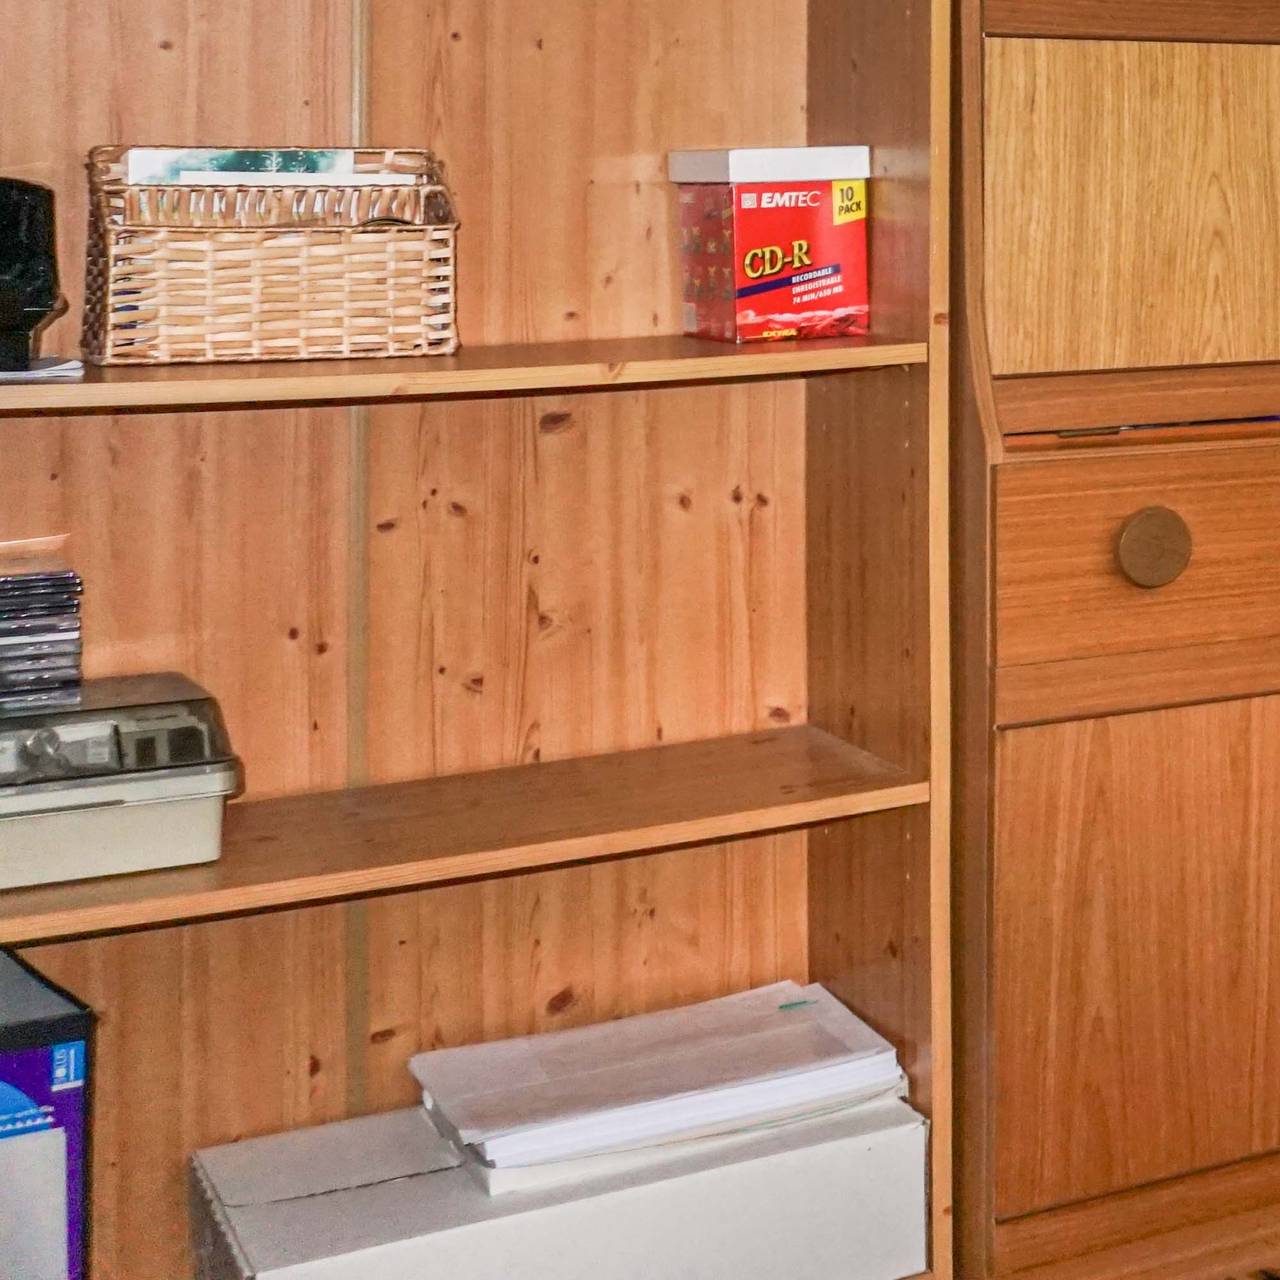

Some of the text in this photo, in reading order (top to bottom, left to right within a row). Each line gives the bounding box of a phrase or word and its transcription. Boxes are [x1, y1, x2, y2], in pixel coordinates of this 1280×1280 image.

[760, 190, 822, 209] EMTEC
[838, 186, 855, 203] 10
[838, 200, 862, 216] PACK
[743, 239, 812, 280] CD-R
[791, 266, 833, 284] RECORDABLE
